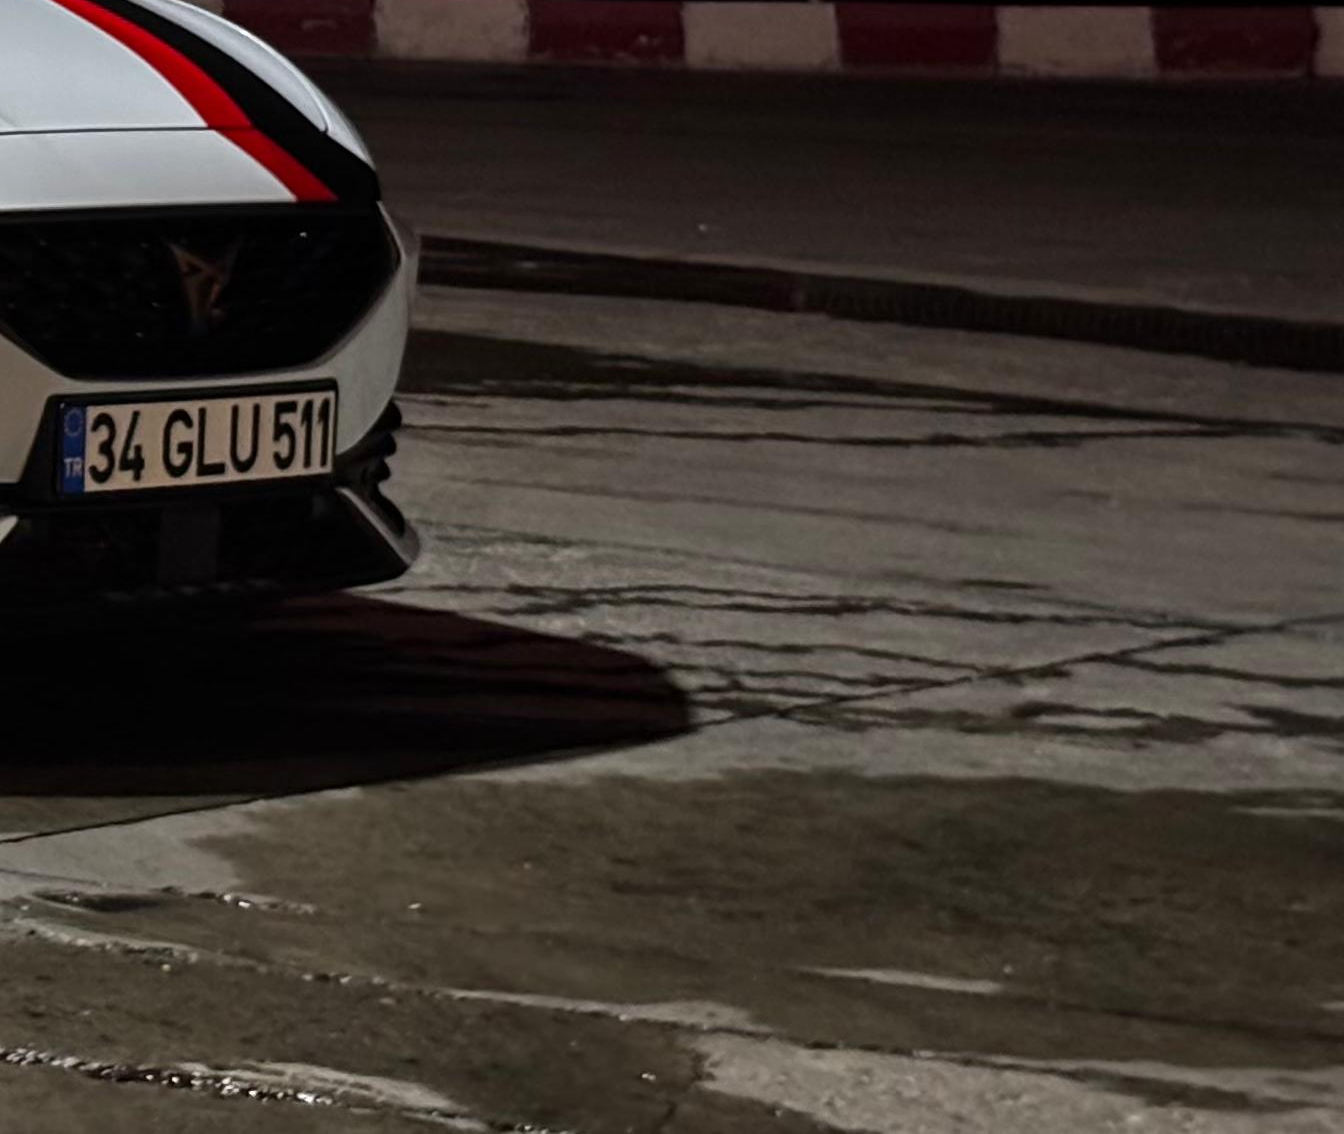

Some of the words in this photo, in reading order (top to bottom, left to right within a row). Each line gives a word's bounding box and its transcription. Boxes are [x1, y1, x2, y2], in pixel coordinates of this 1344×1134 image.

[64, 457, 83, 478] TR
[88, 411, 145, 484] 34
[162, 403, 261, 478] GLU
[273, 398, 331, 470] 511
